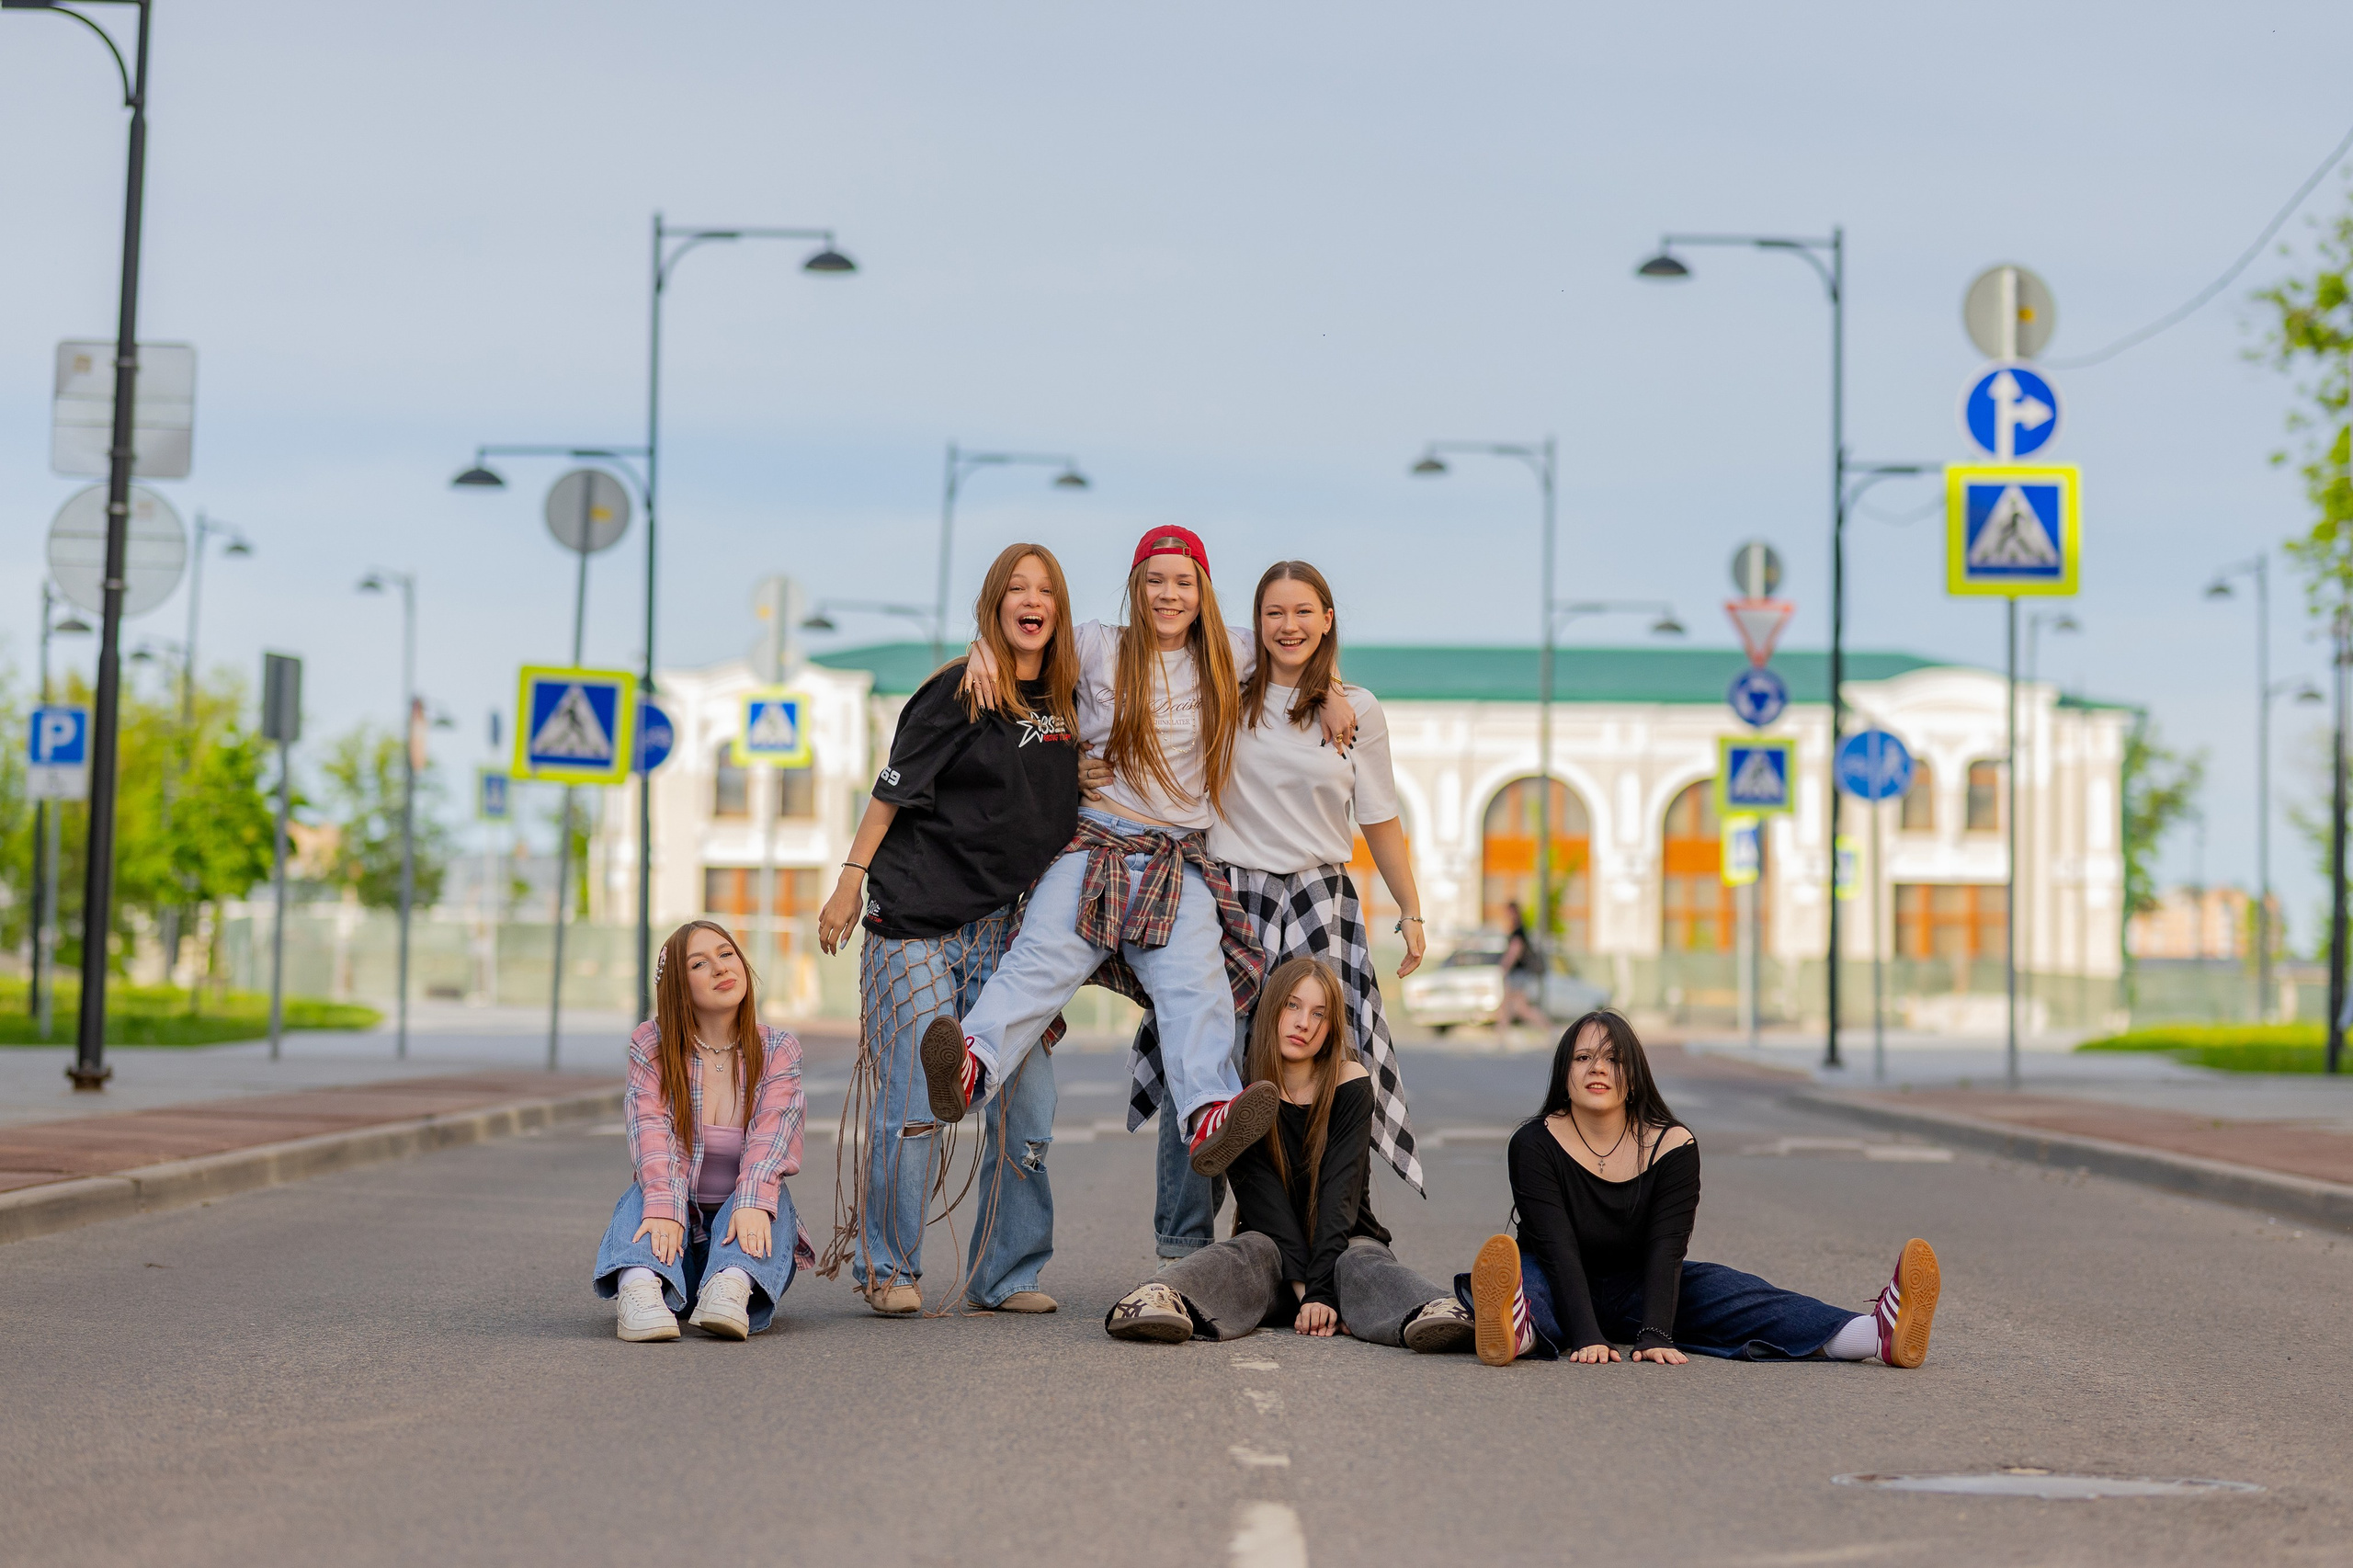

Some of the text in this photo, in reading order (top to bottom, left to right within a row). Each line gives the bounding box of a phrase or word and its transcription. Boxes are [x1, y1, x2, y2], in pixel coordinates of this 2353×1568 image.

[1150, 697, 1203, 714] Decisio
[40, 713, 76, 762] P
[880, 766, 901, 787] 69
